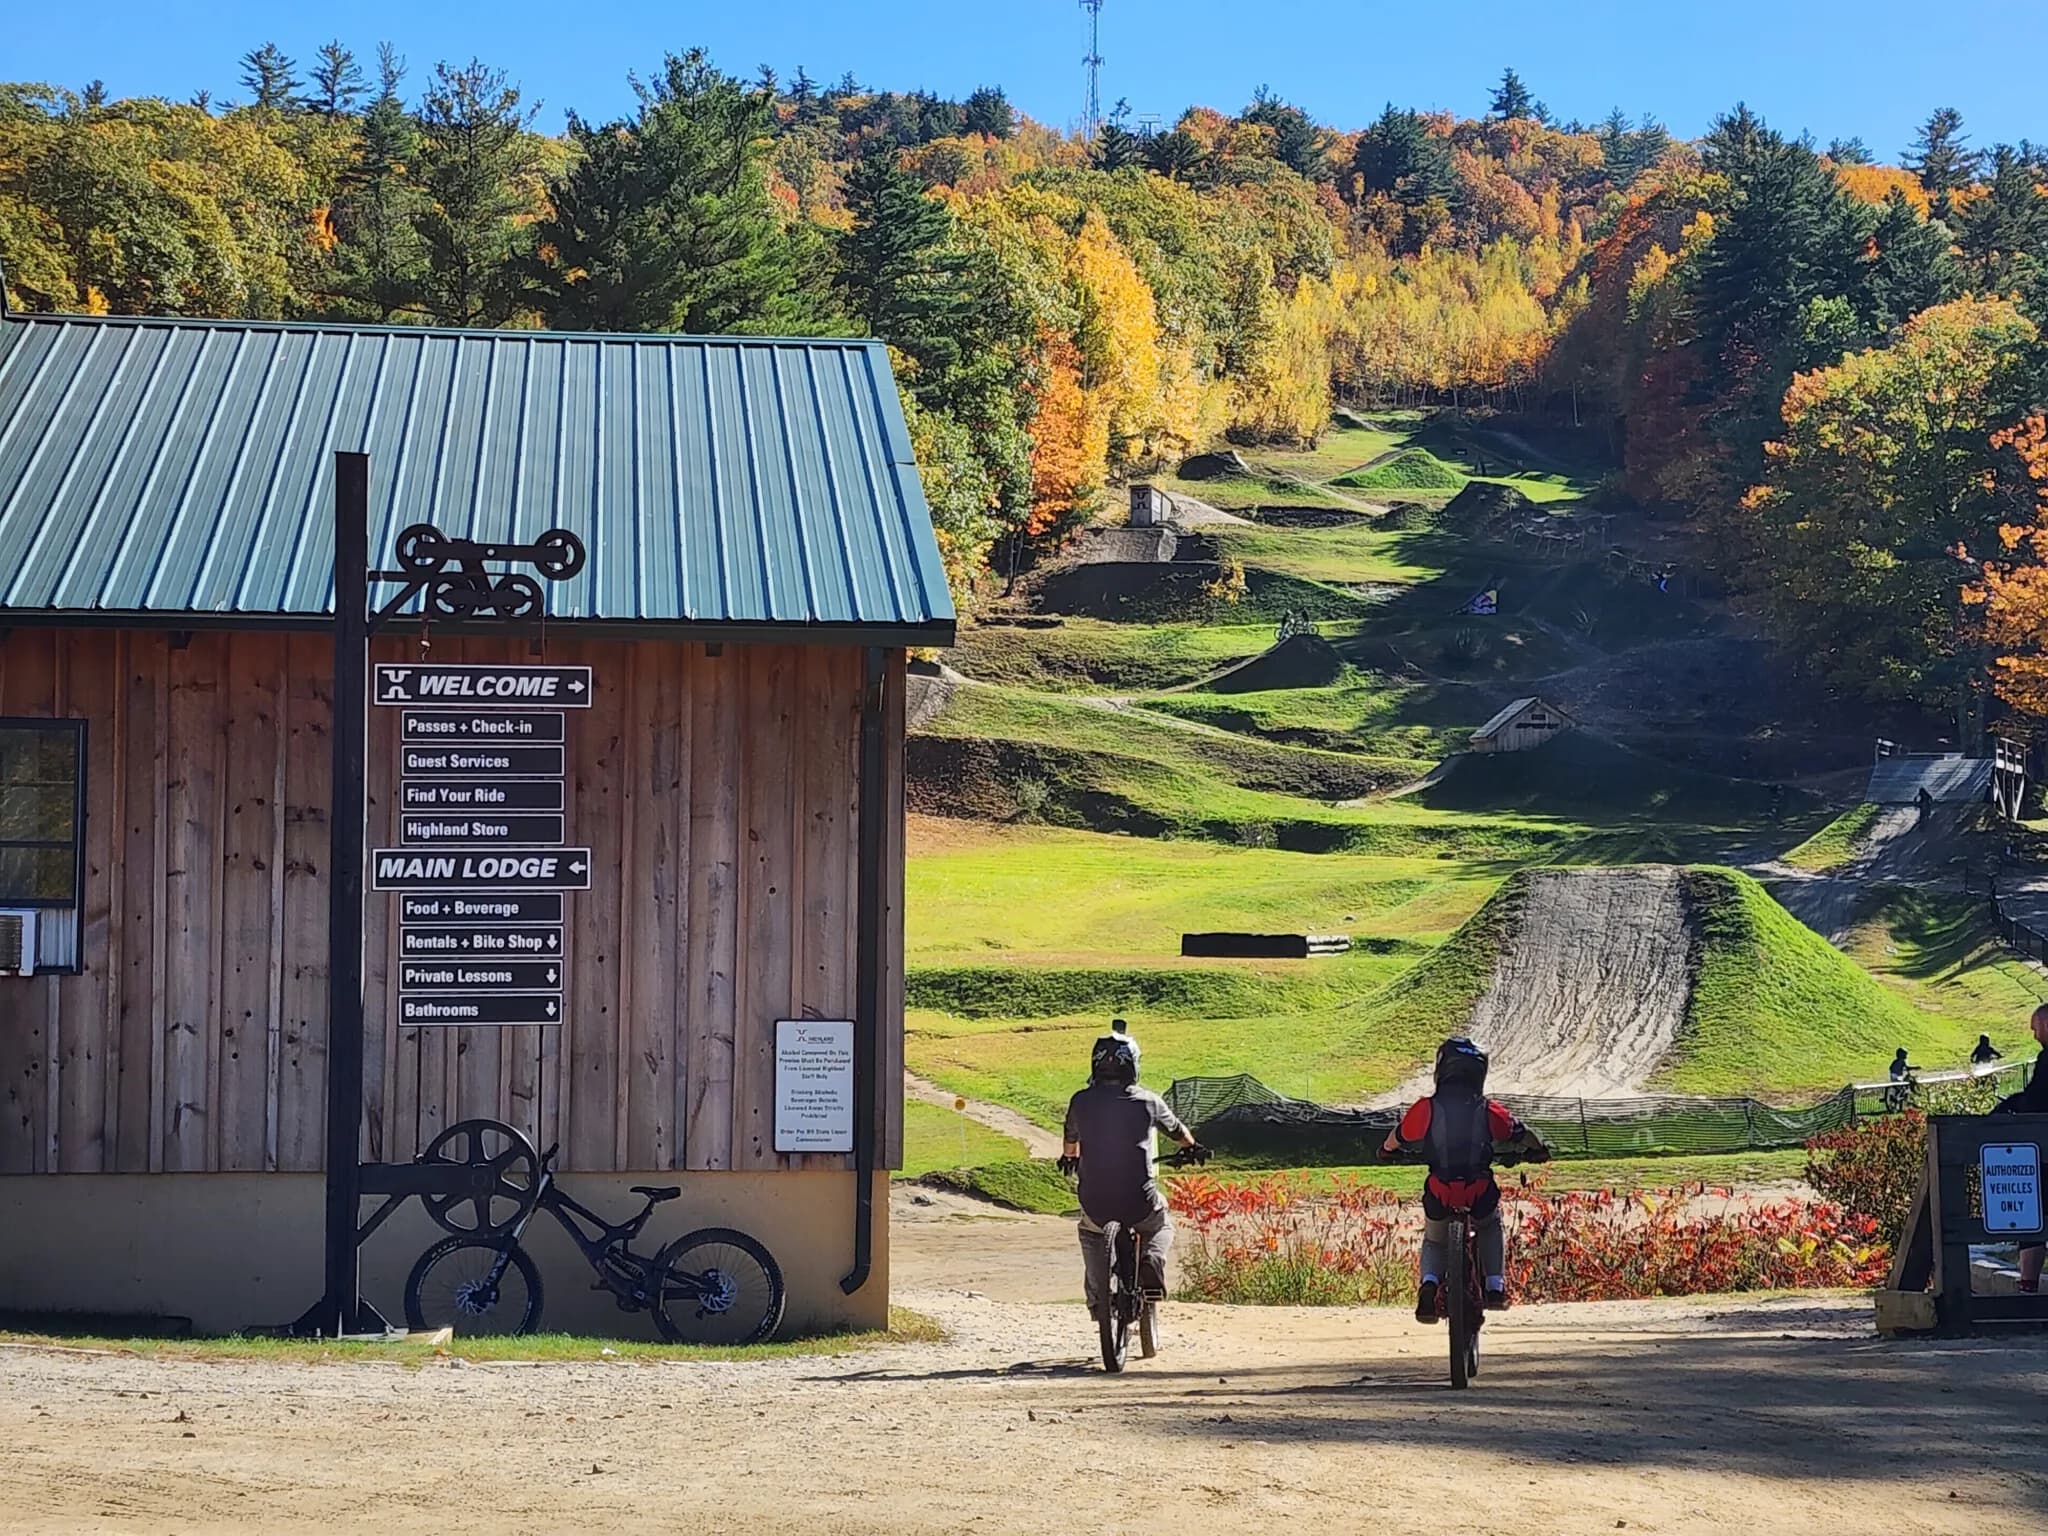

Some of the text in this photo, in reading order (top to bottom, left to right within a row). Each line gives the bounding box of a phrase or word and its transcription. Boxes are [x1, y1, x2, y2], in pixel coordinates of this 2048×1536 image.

[419, 675, 559, 697] WELCOME
[407, 719, 532, 734] Passes + Check-in
[407, 754, 510, 768] Guest Services
[407, 788, 506, 802] Find Your Ride
[407, 822, 508, 839] Highland Store
[378, 858, 558, 878] MAIN LODGE
[406, 901, 519, 917] Food + Beverage
[406, 934, 543, 952] Rentals + Bike Shop
[405, 968, 513, 983] Private Lessons
[404, 1003, 479, 1017] Bathrooms
[1986, 1164, 2036, 1177] AUTHORIZED
[1990, 1182, 2033, 1195] VEHICLES
[2000, 1200, 2025, 1212] ONLY
